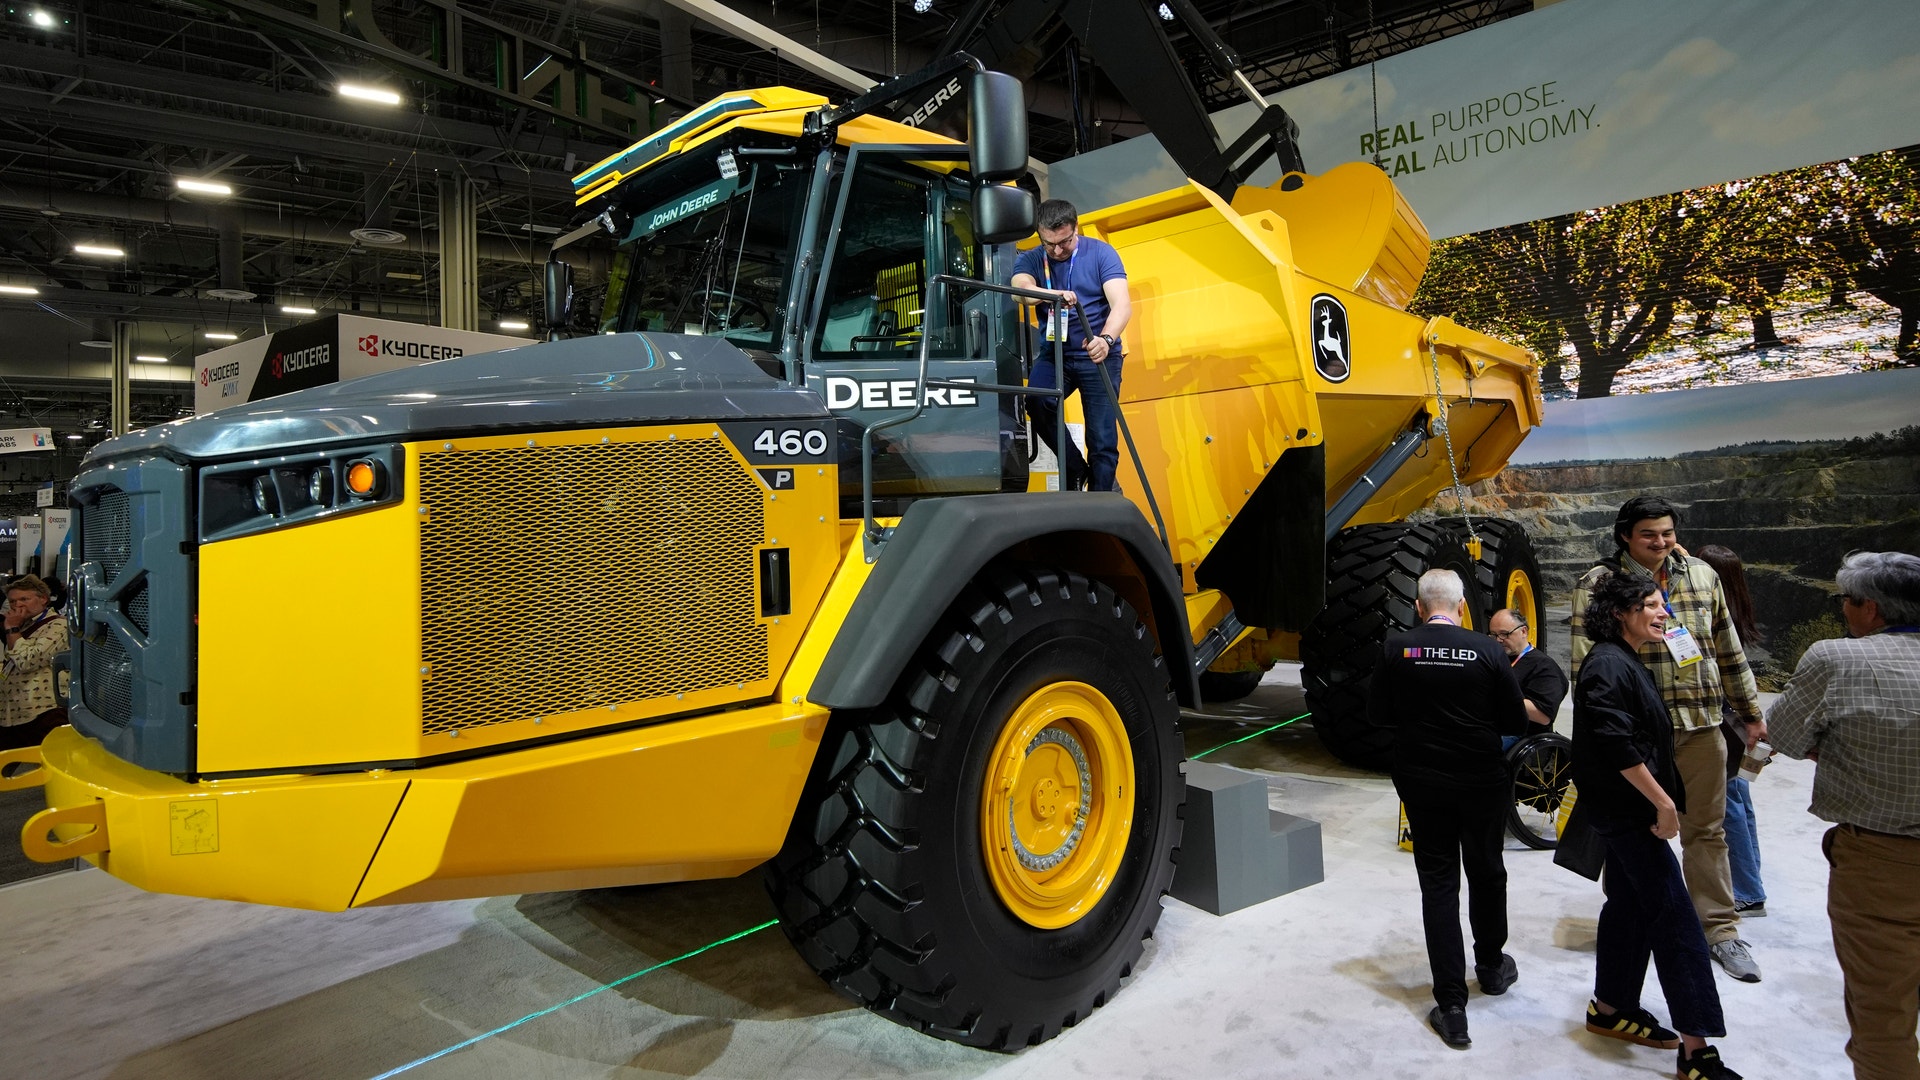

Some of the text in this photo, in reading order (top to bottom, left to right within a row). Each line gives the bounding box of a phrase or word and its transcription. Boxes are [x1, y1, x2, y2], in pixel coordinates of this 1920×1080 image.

[1360, 81, 1565, 156] REAL PURPOSE.
[1370, 103, 1600, 179] EAL AUTONOMY.
[648, 189, 719, 230] JOHN DEERE
[208, 361, 240, 383] KYOCERA
[283, 344, 330, 373] KYOCERA
[826, 377, 977, 410] DEERE
[754, 429, 828, 455] 460
[775, 471, 791, 488] P
[1423, 647, 1478, 661] THE LED
